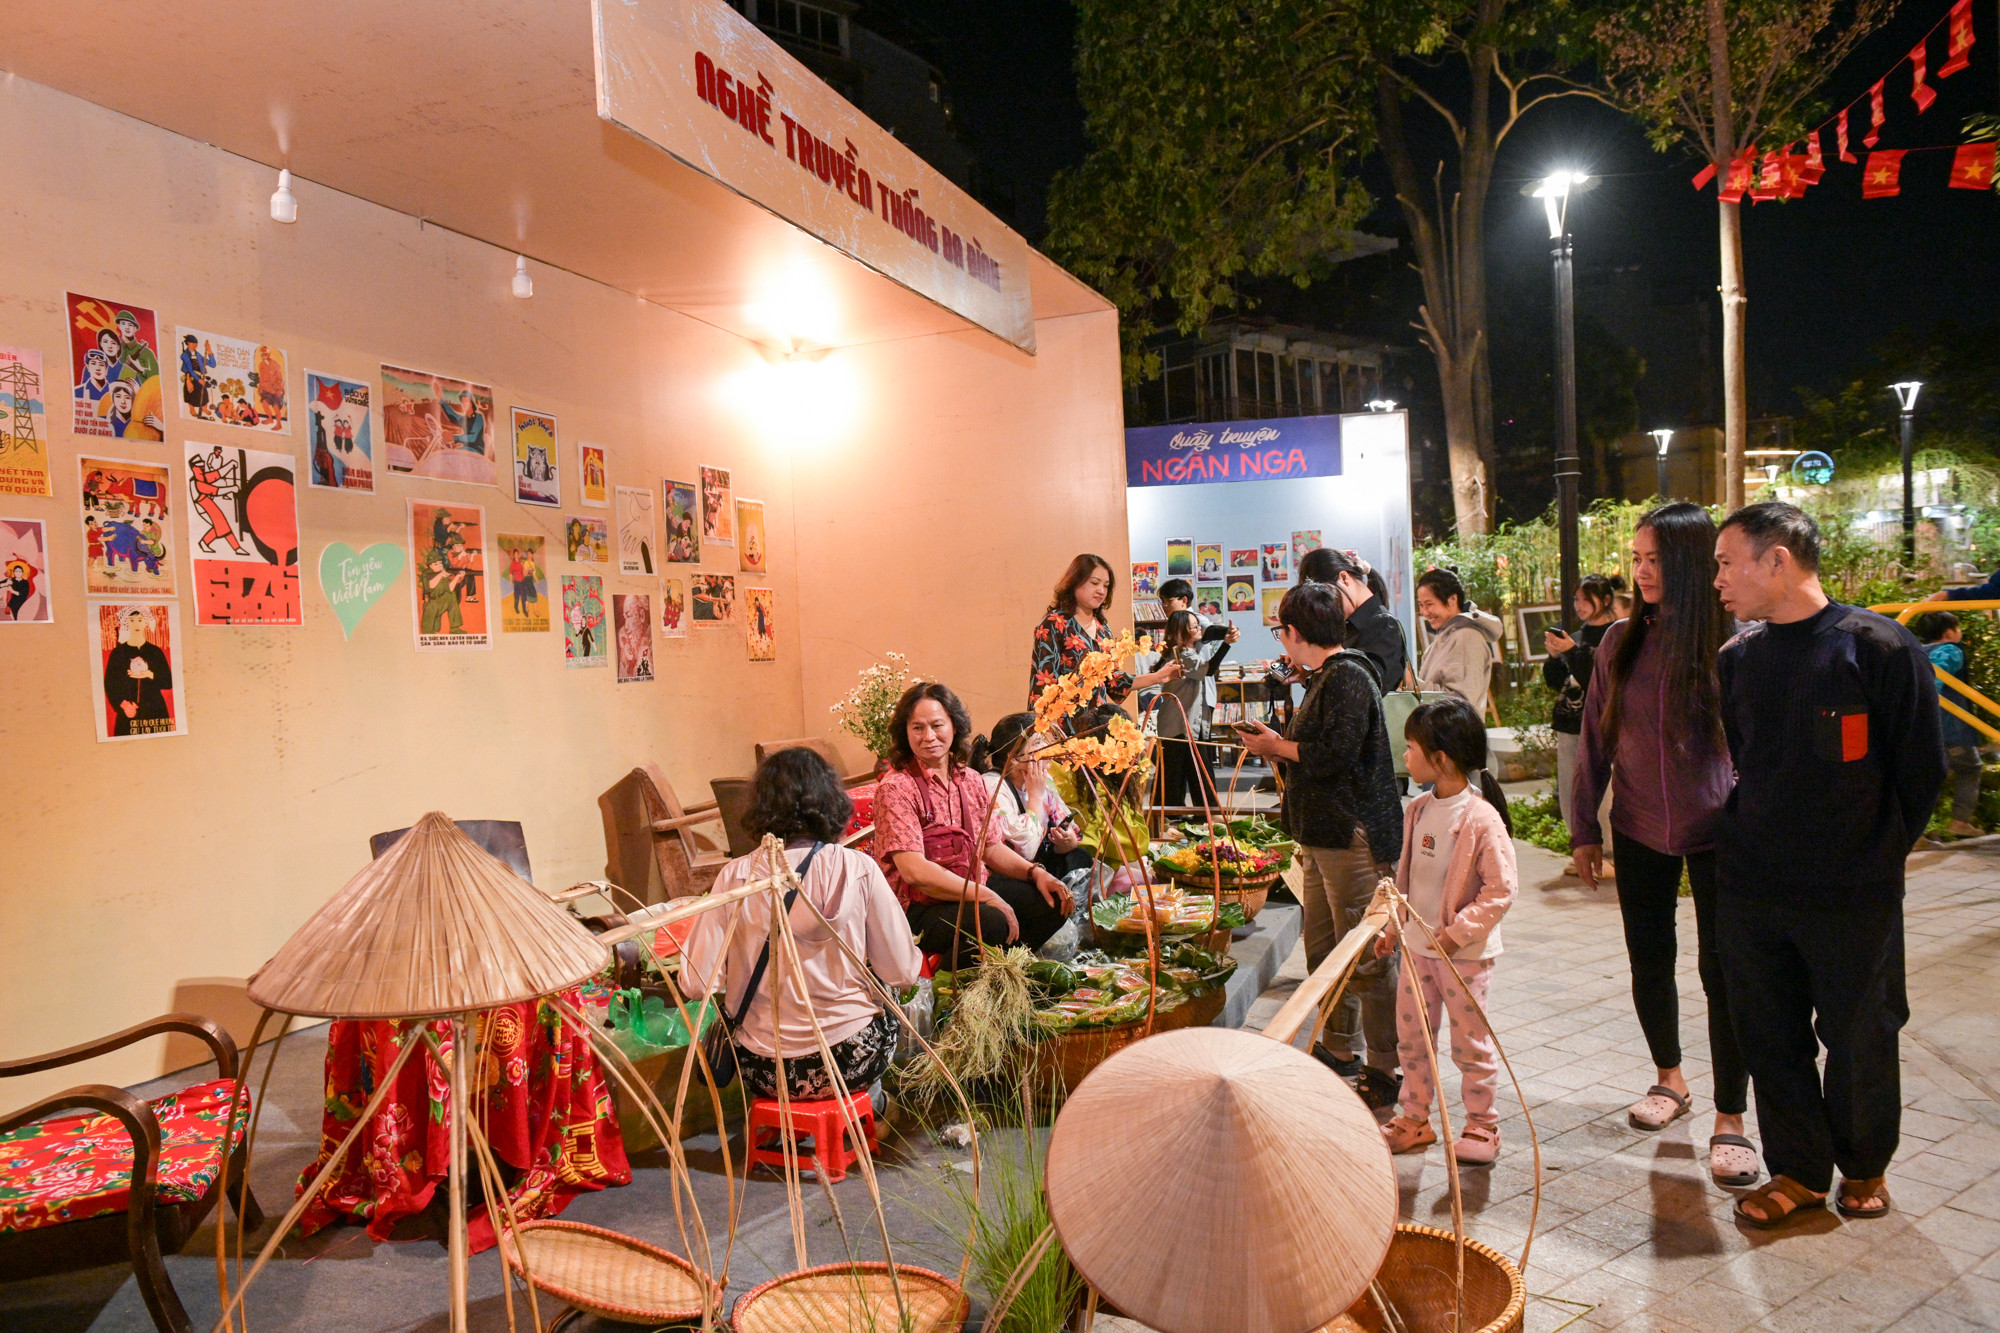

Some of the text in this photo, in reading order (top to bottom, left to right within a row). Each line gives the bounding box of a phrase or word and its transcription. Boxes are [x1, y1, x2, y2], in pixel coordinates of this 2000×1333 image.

[695, 51, 775, 148] NGHỀ
[780, 111, 873, 213] TRUYỀN
[877, 180, 939, 253] THỐNG
[942, 224, 964, 271] BA
[1169, 427, 1281, 452] Quầy truyện
[1240, 448, 1308, 475] NGA
[332, 579, 384, 605] Việt Nam
